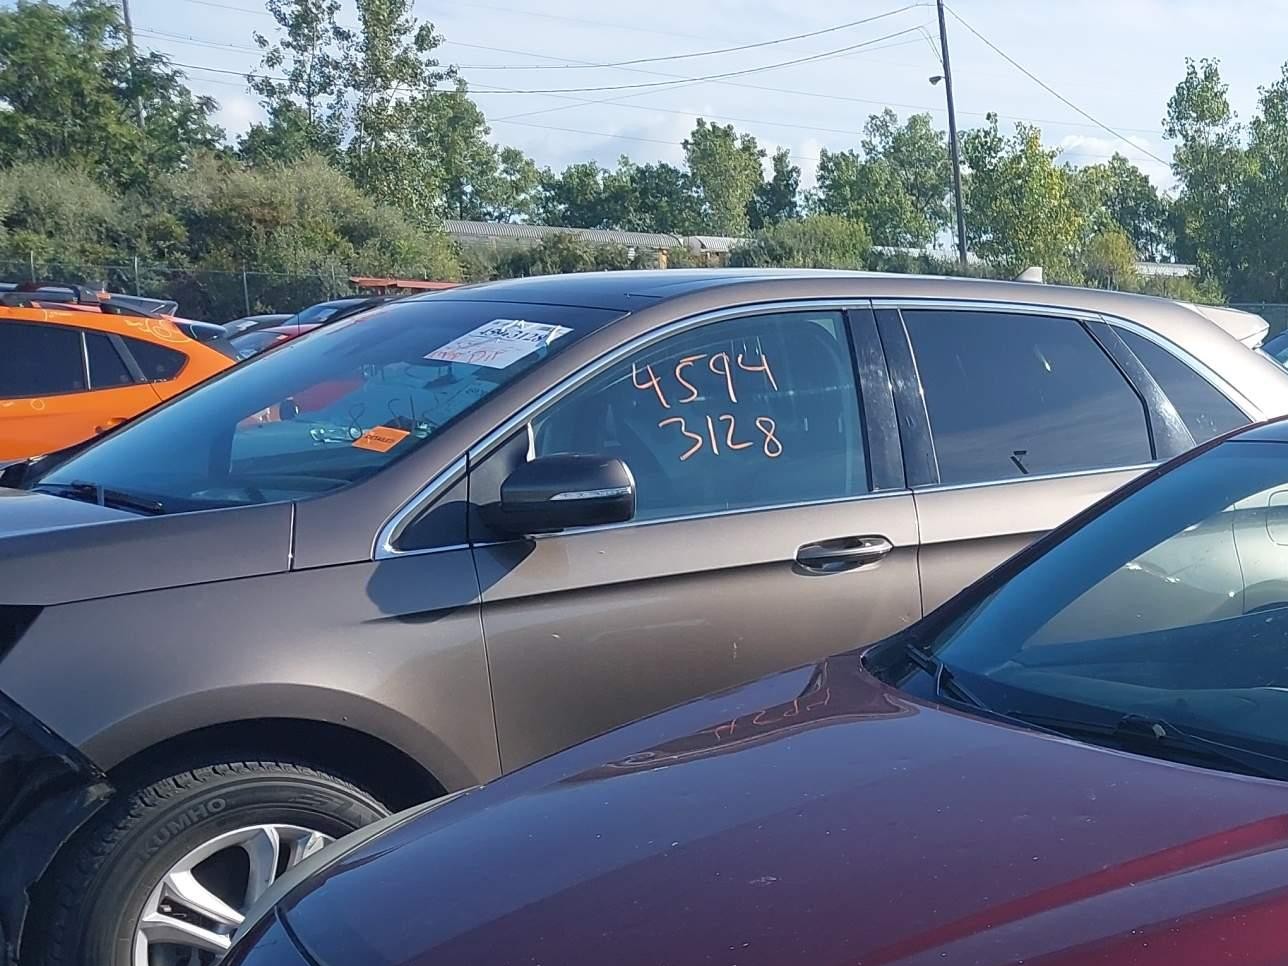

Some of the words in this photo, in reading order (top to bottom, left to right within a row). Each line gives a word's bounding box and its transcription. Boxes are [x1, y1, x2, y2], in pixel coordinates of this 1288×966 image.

[631, 351, 779, 409] 4594
[658, 414, 783, 461] 3128
[137, 798, 227, 860] KUMHO
